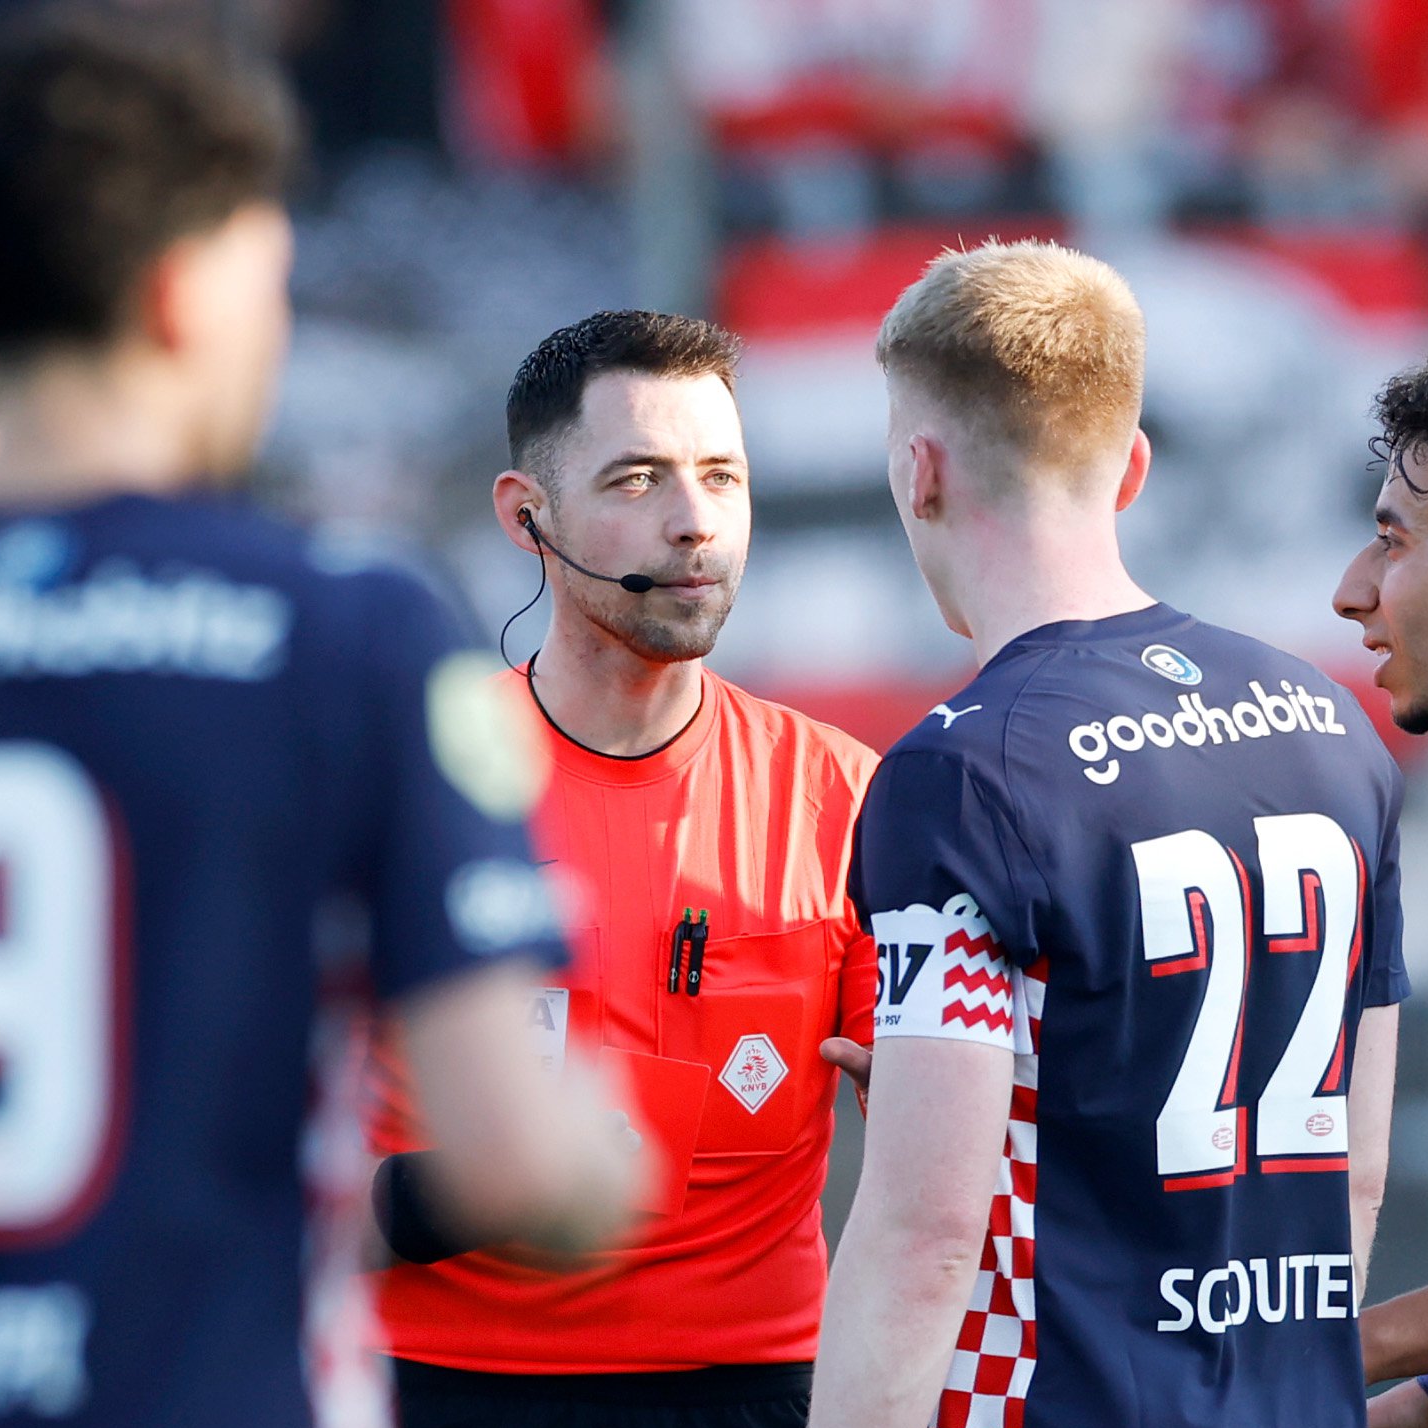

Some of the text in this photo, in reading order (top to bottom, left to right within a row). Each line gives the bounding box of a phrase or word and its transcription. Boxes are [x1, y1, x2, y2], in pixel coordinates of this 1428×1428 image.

[1069, 680, 1346, 785] goodhabitz
[1130, 813, 1363, 1188] 22
[741, 1083, 767, 1092] KNVB
